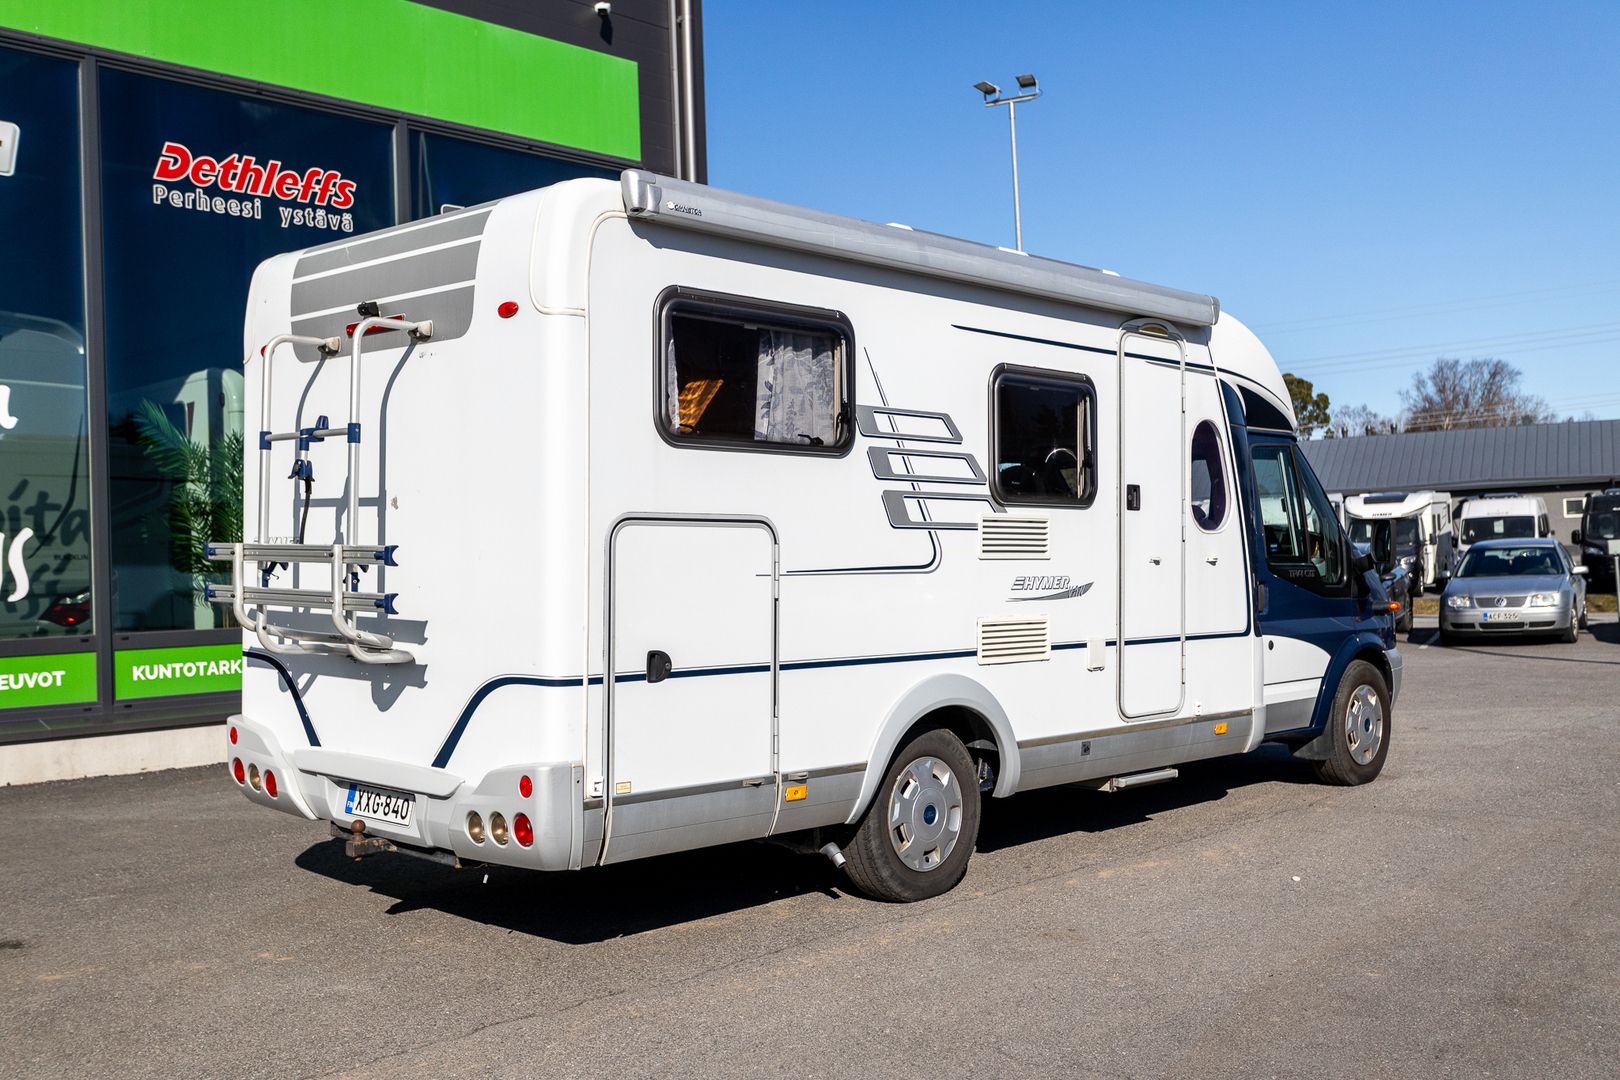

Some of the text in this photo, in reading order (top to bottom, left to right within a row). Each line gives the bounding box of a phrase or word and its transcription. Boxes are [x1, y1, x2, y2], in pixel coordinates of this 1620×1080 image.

[153, 141, 357, 209] Dethleffs
[152, 184, 354, 233] Perheesi ystävä
[1022, 575, 1071, 591] HYMER
[132, 659, 242, 682] KUNTOTARK
[355, 789, 410, 820] XXG-840
